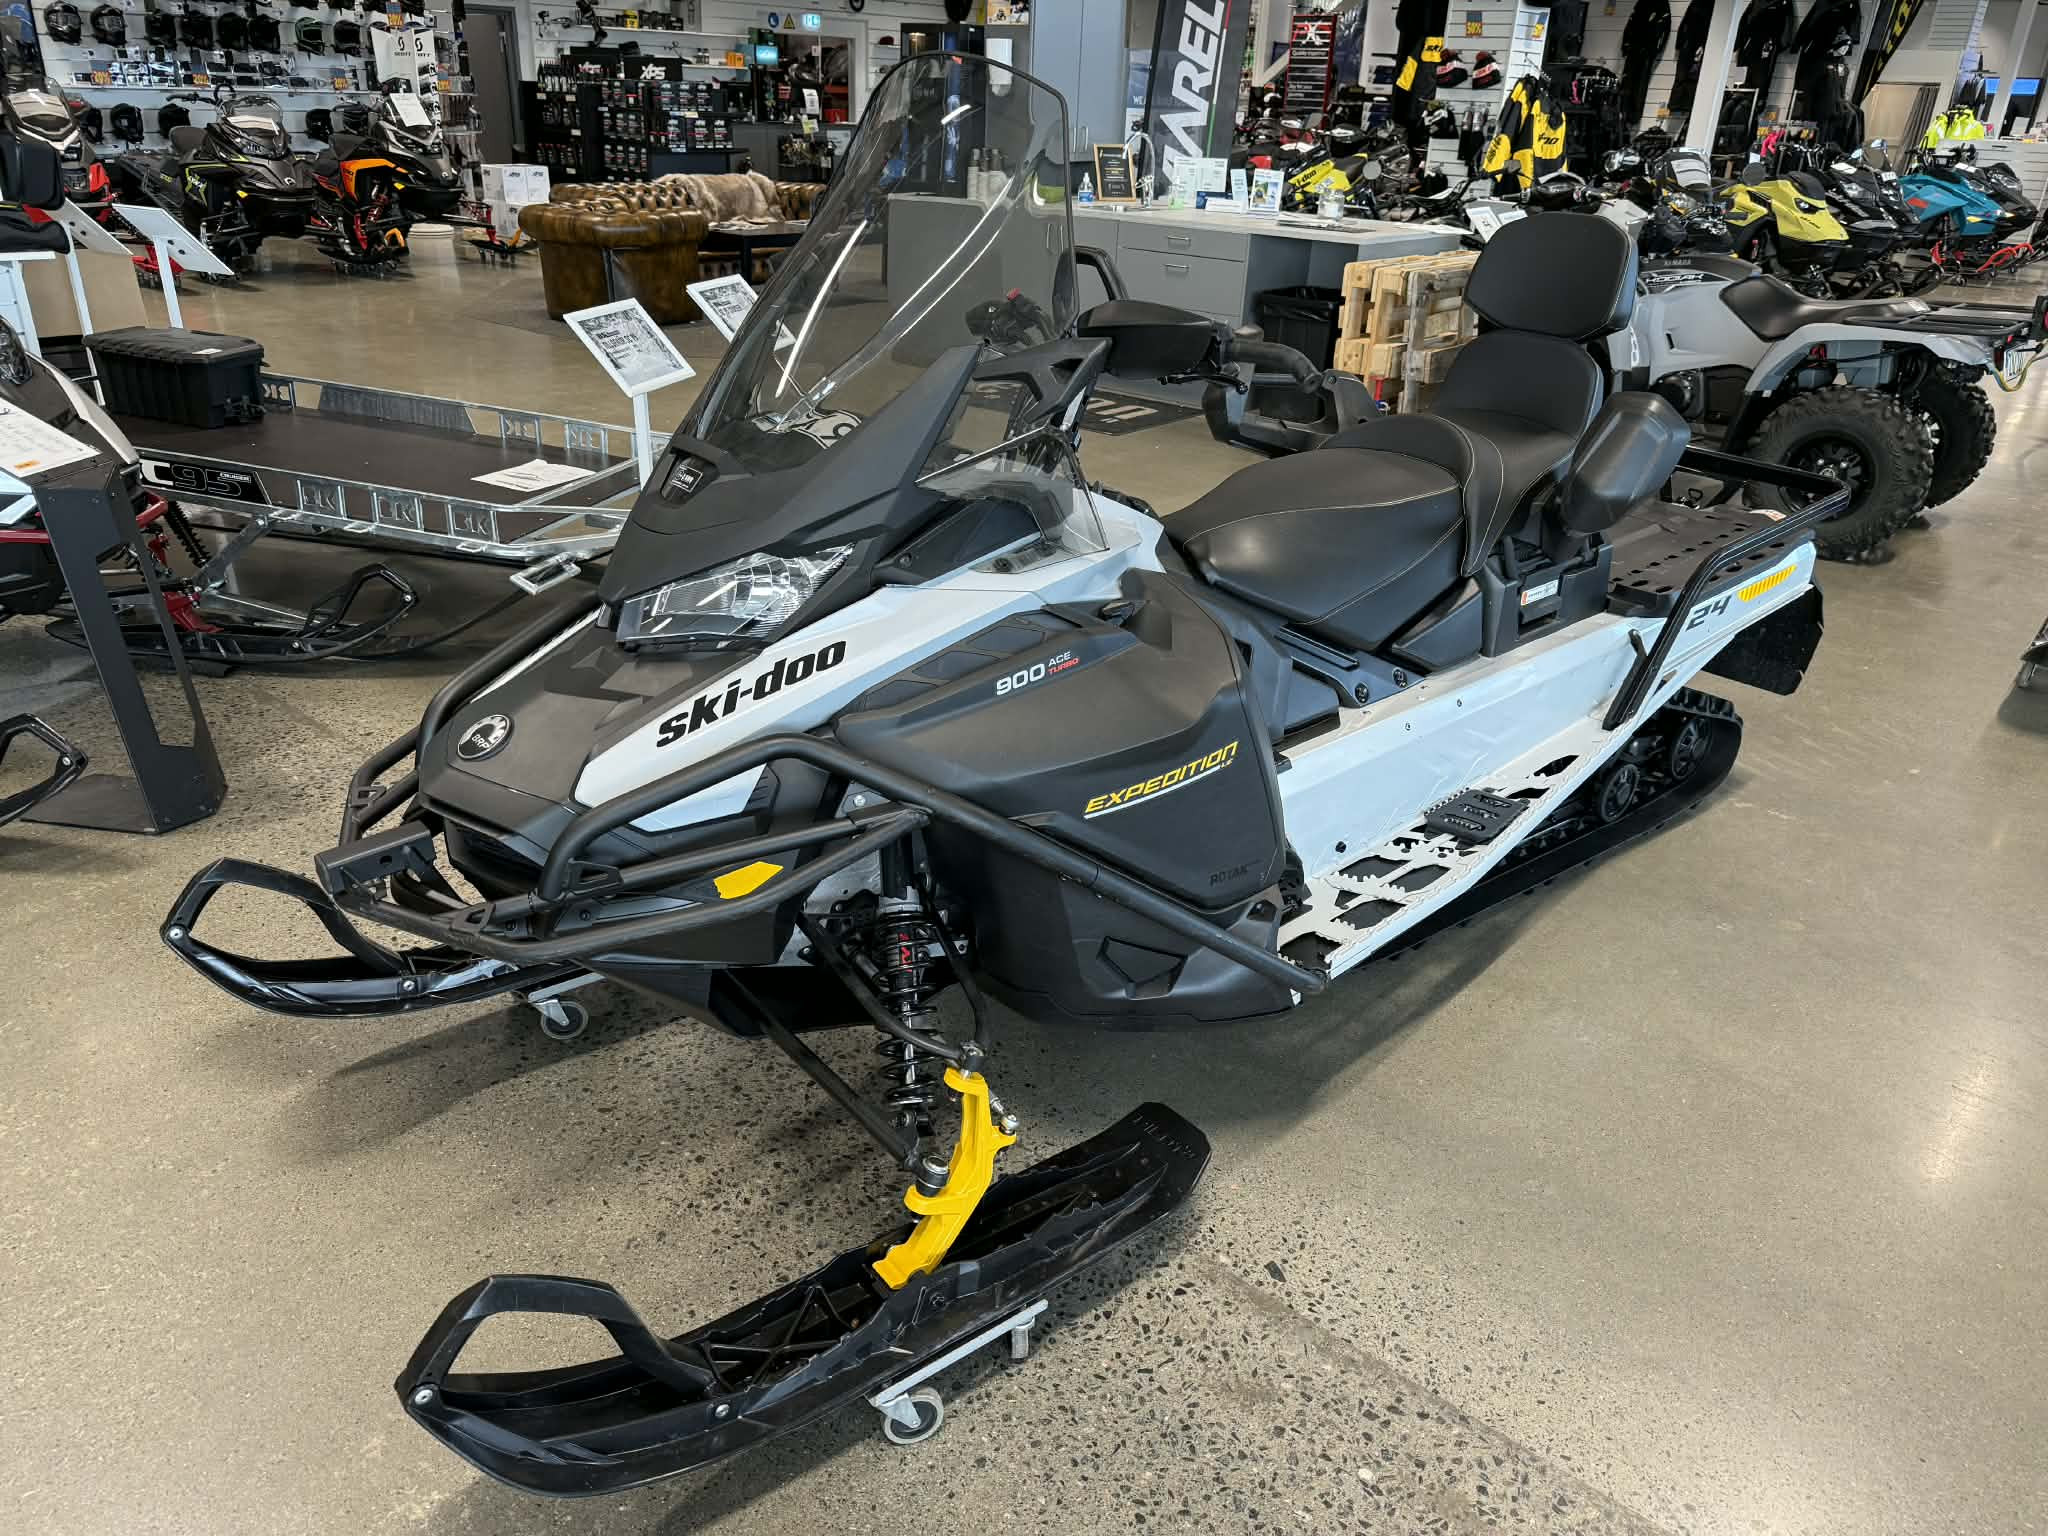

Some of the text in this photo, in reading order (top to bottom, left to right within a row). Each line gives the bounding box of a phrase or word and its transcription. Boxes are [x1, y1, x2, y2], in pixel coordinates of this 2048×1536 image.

[640, 63, 667, 80] XPS
[1645, 273, 1705, 283] KODIAK
[1685, 595, 1732, 631] 24
[996, 651, 1071, 695] 900 ACE
[1047, 657, 1080, 674] TURBO
[656, 640, 847, 748] ski-doo
[471, 734, 491, 748] BRP
[1084, 741, 1239, 813] EXPEDITION
